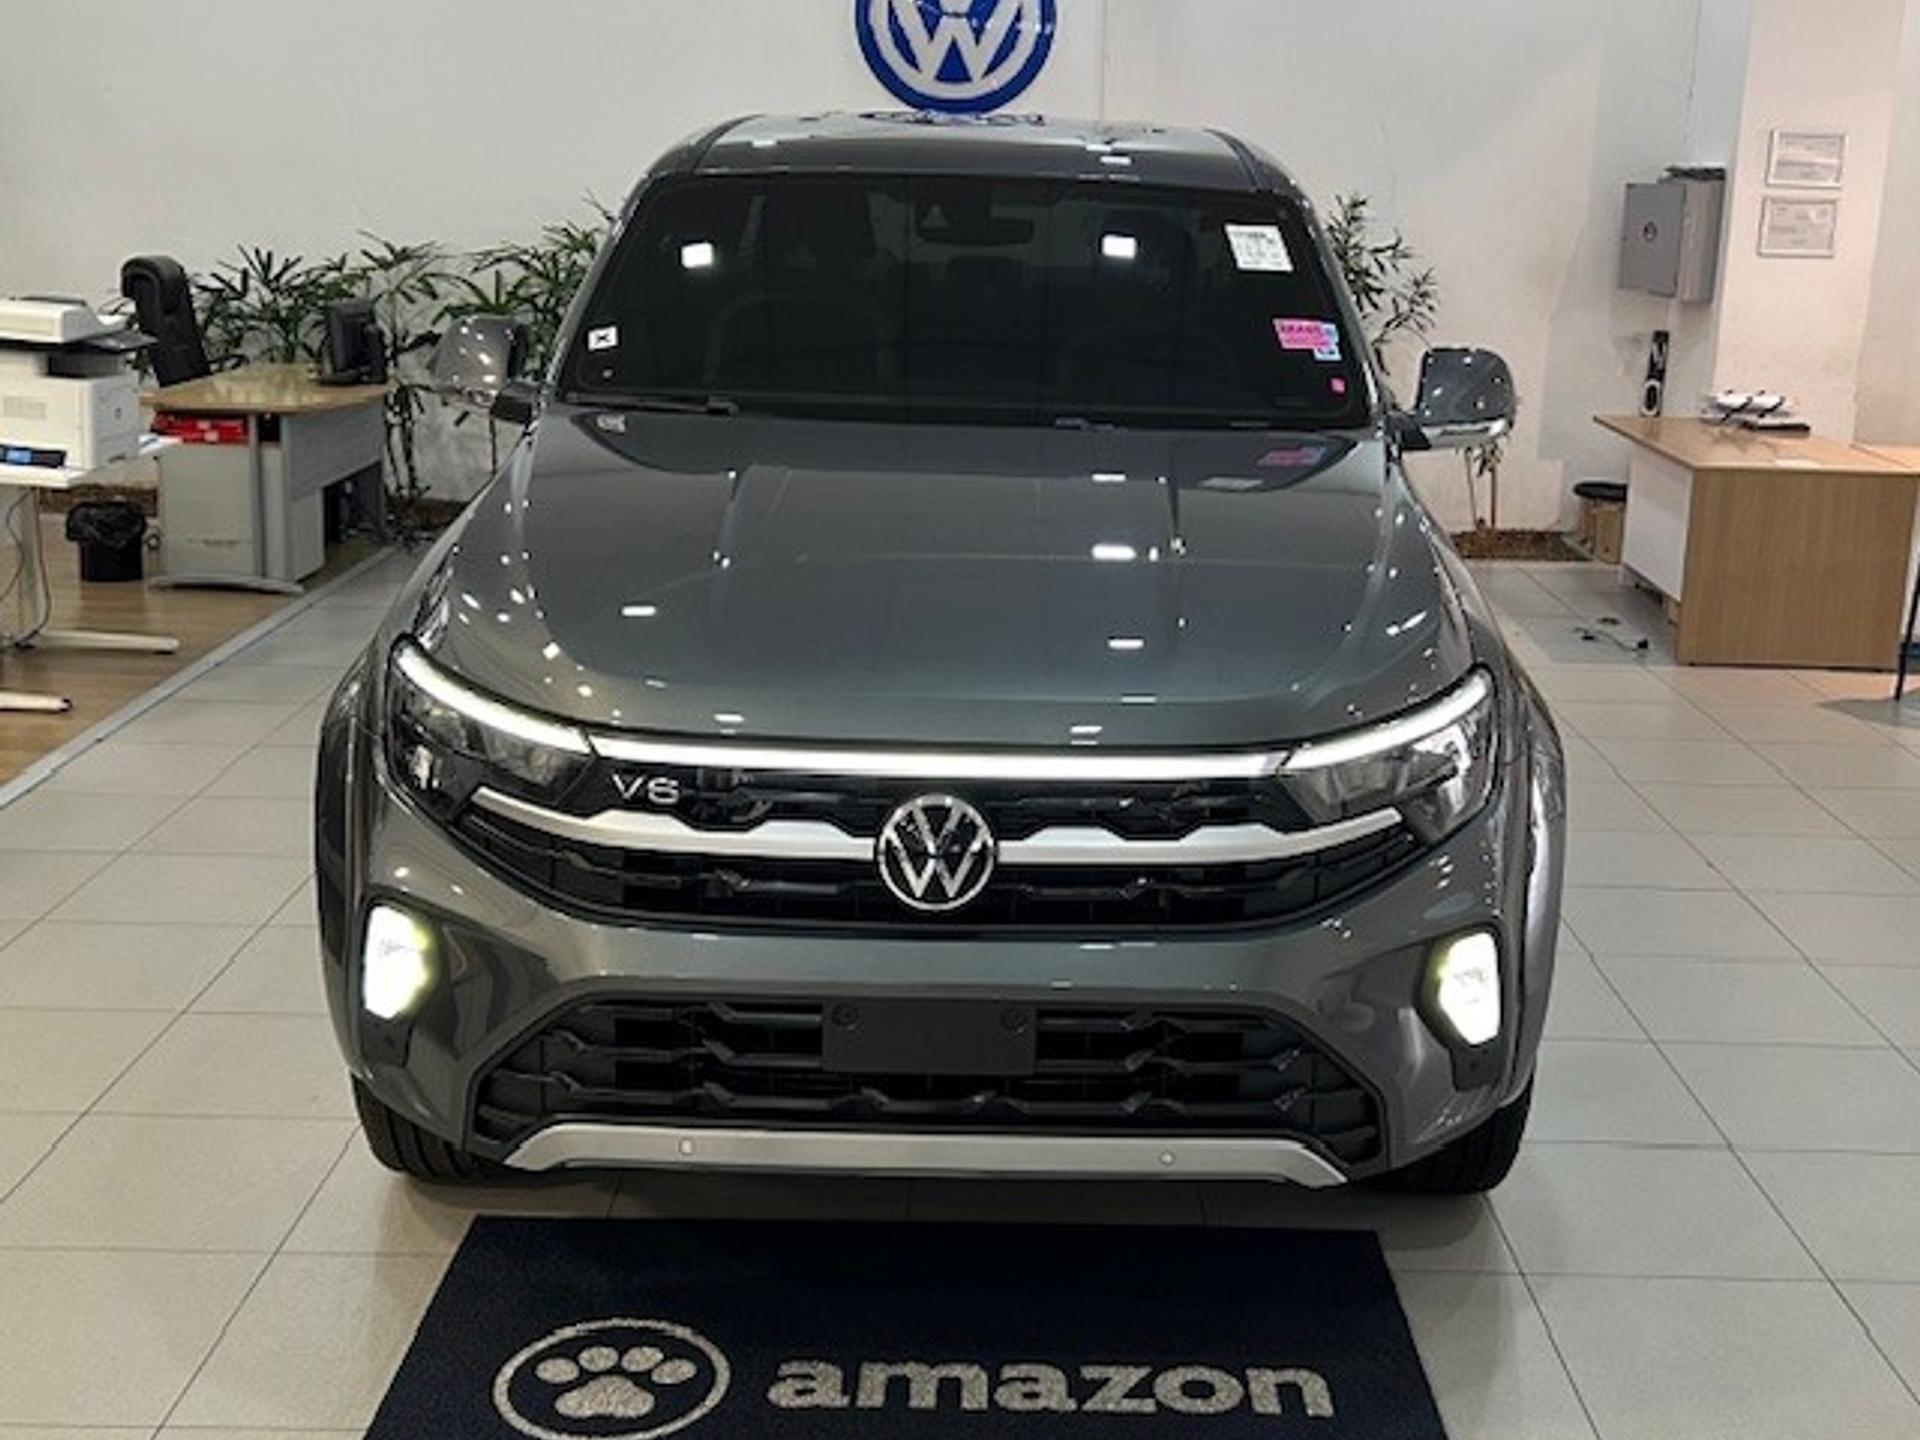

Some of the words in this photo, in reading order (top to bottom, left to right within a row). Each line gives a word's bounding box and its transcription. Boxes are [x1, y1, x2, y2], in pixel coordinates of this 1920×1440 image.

[611, 772, 680, 804] V6
[882, 797, 994, 906] VW
[768, 1358, 1334, 1418] amazon
